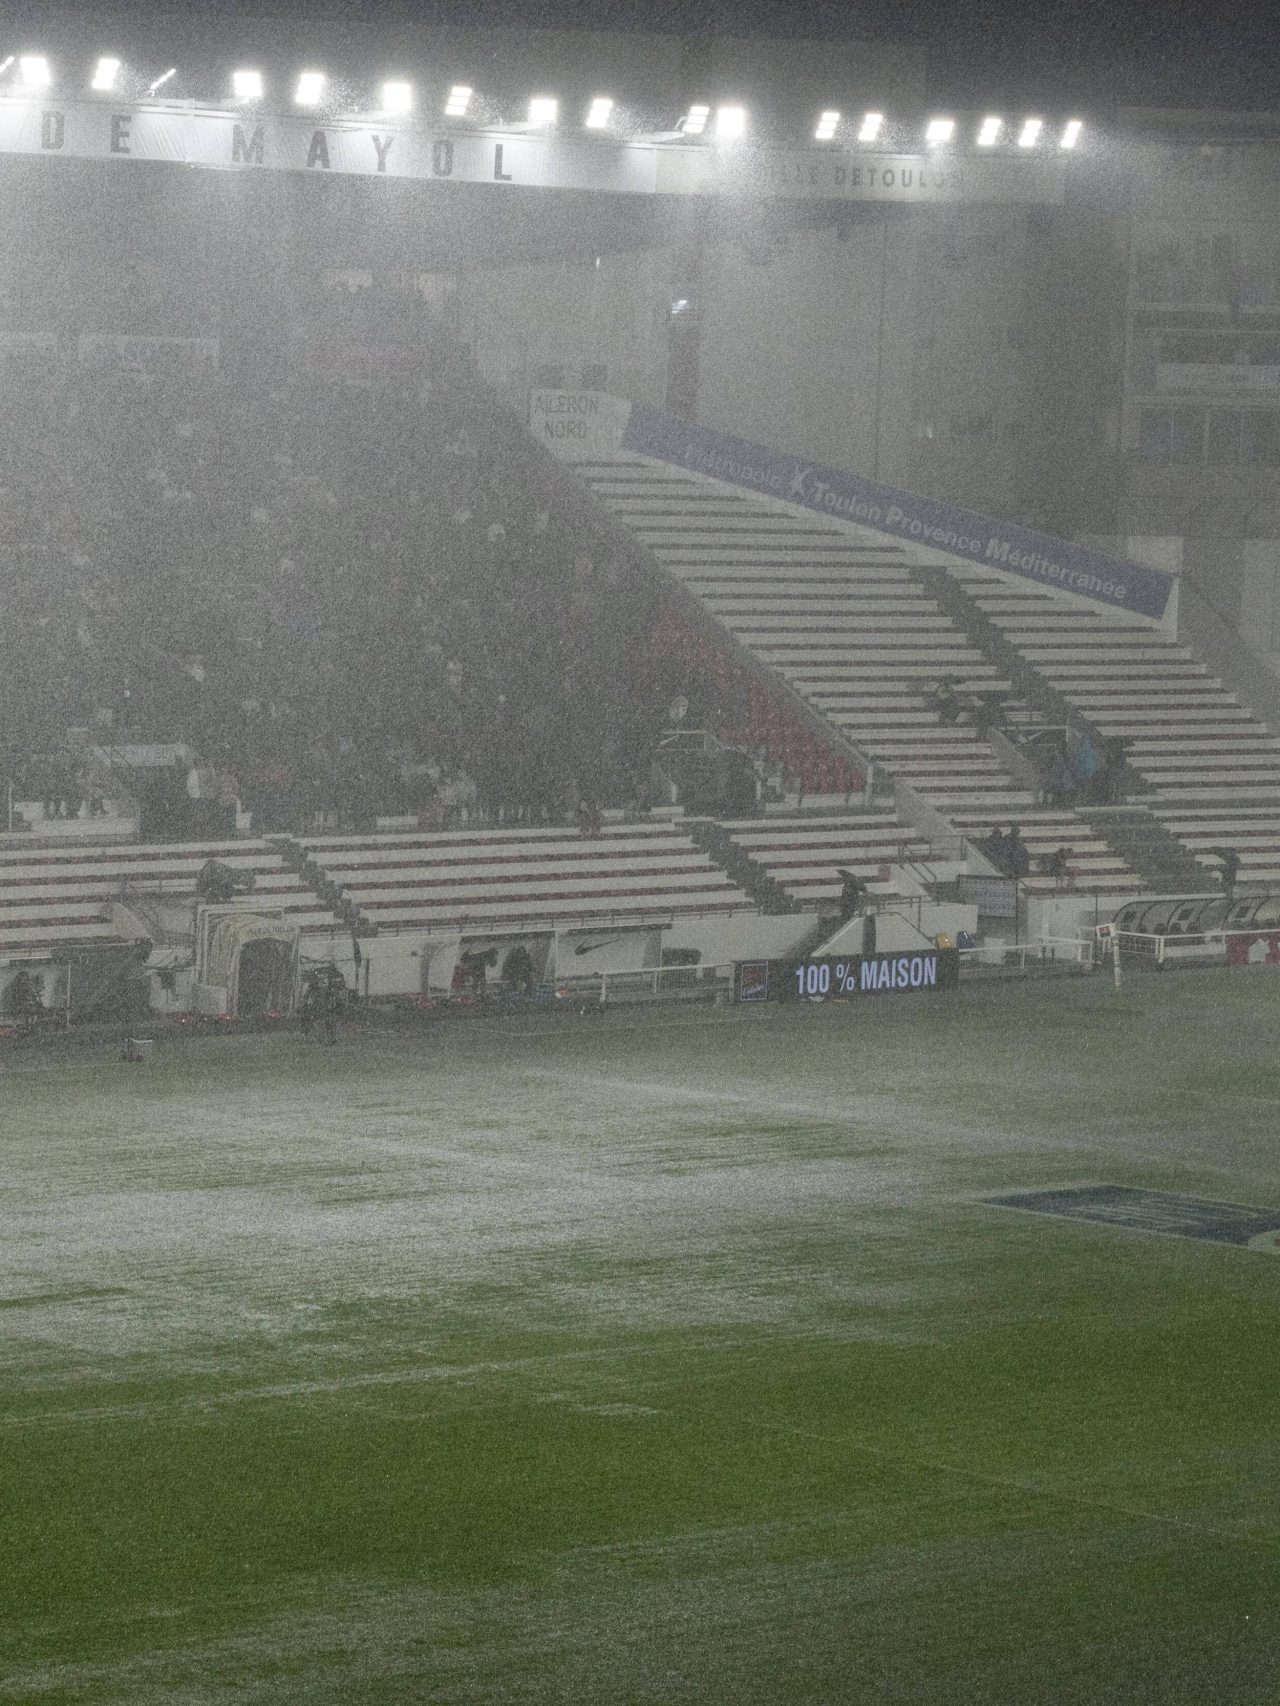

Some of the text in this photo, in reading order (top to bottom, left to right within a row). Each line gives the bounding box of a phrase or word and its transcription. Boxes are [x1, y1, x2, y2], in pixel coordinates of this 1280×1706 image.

[231, 121, 513, 181] MAYOL
[544, 420, 588, 440] NORD
[813, 480, 882, 521] Toulon
[885, 505, 982, 553] Provence
[985, 536, 1128, 600] Méditerranée
[796, 964, 829, 994] 100
[836, 962, 855, 992] %
[861, 956, 937, 990] MAISON
